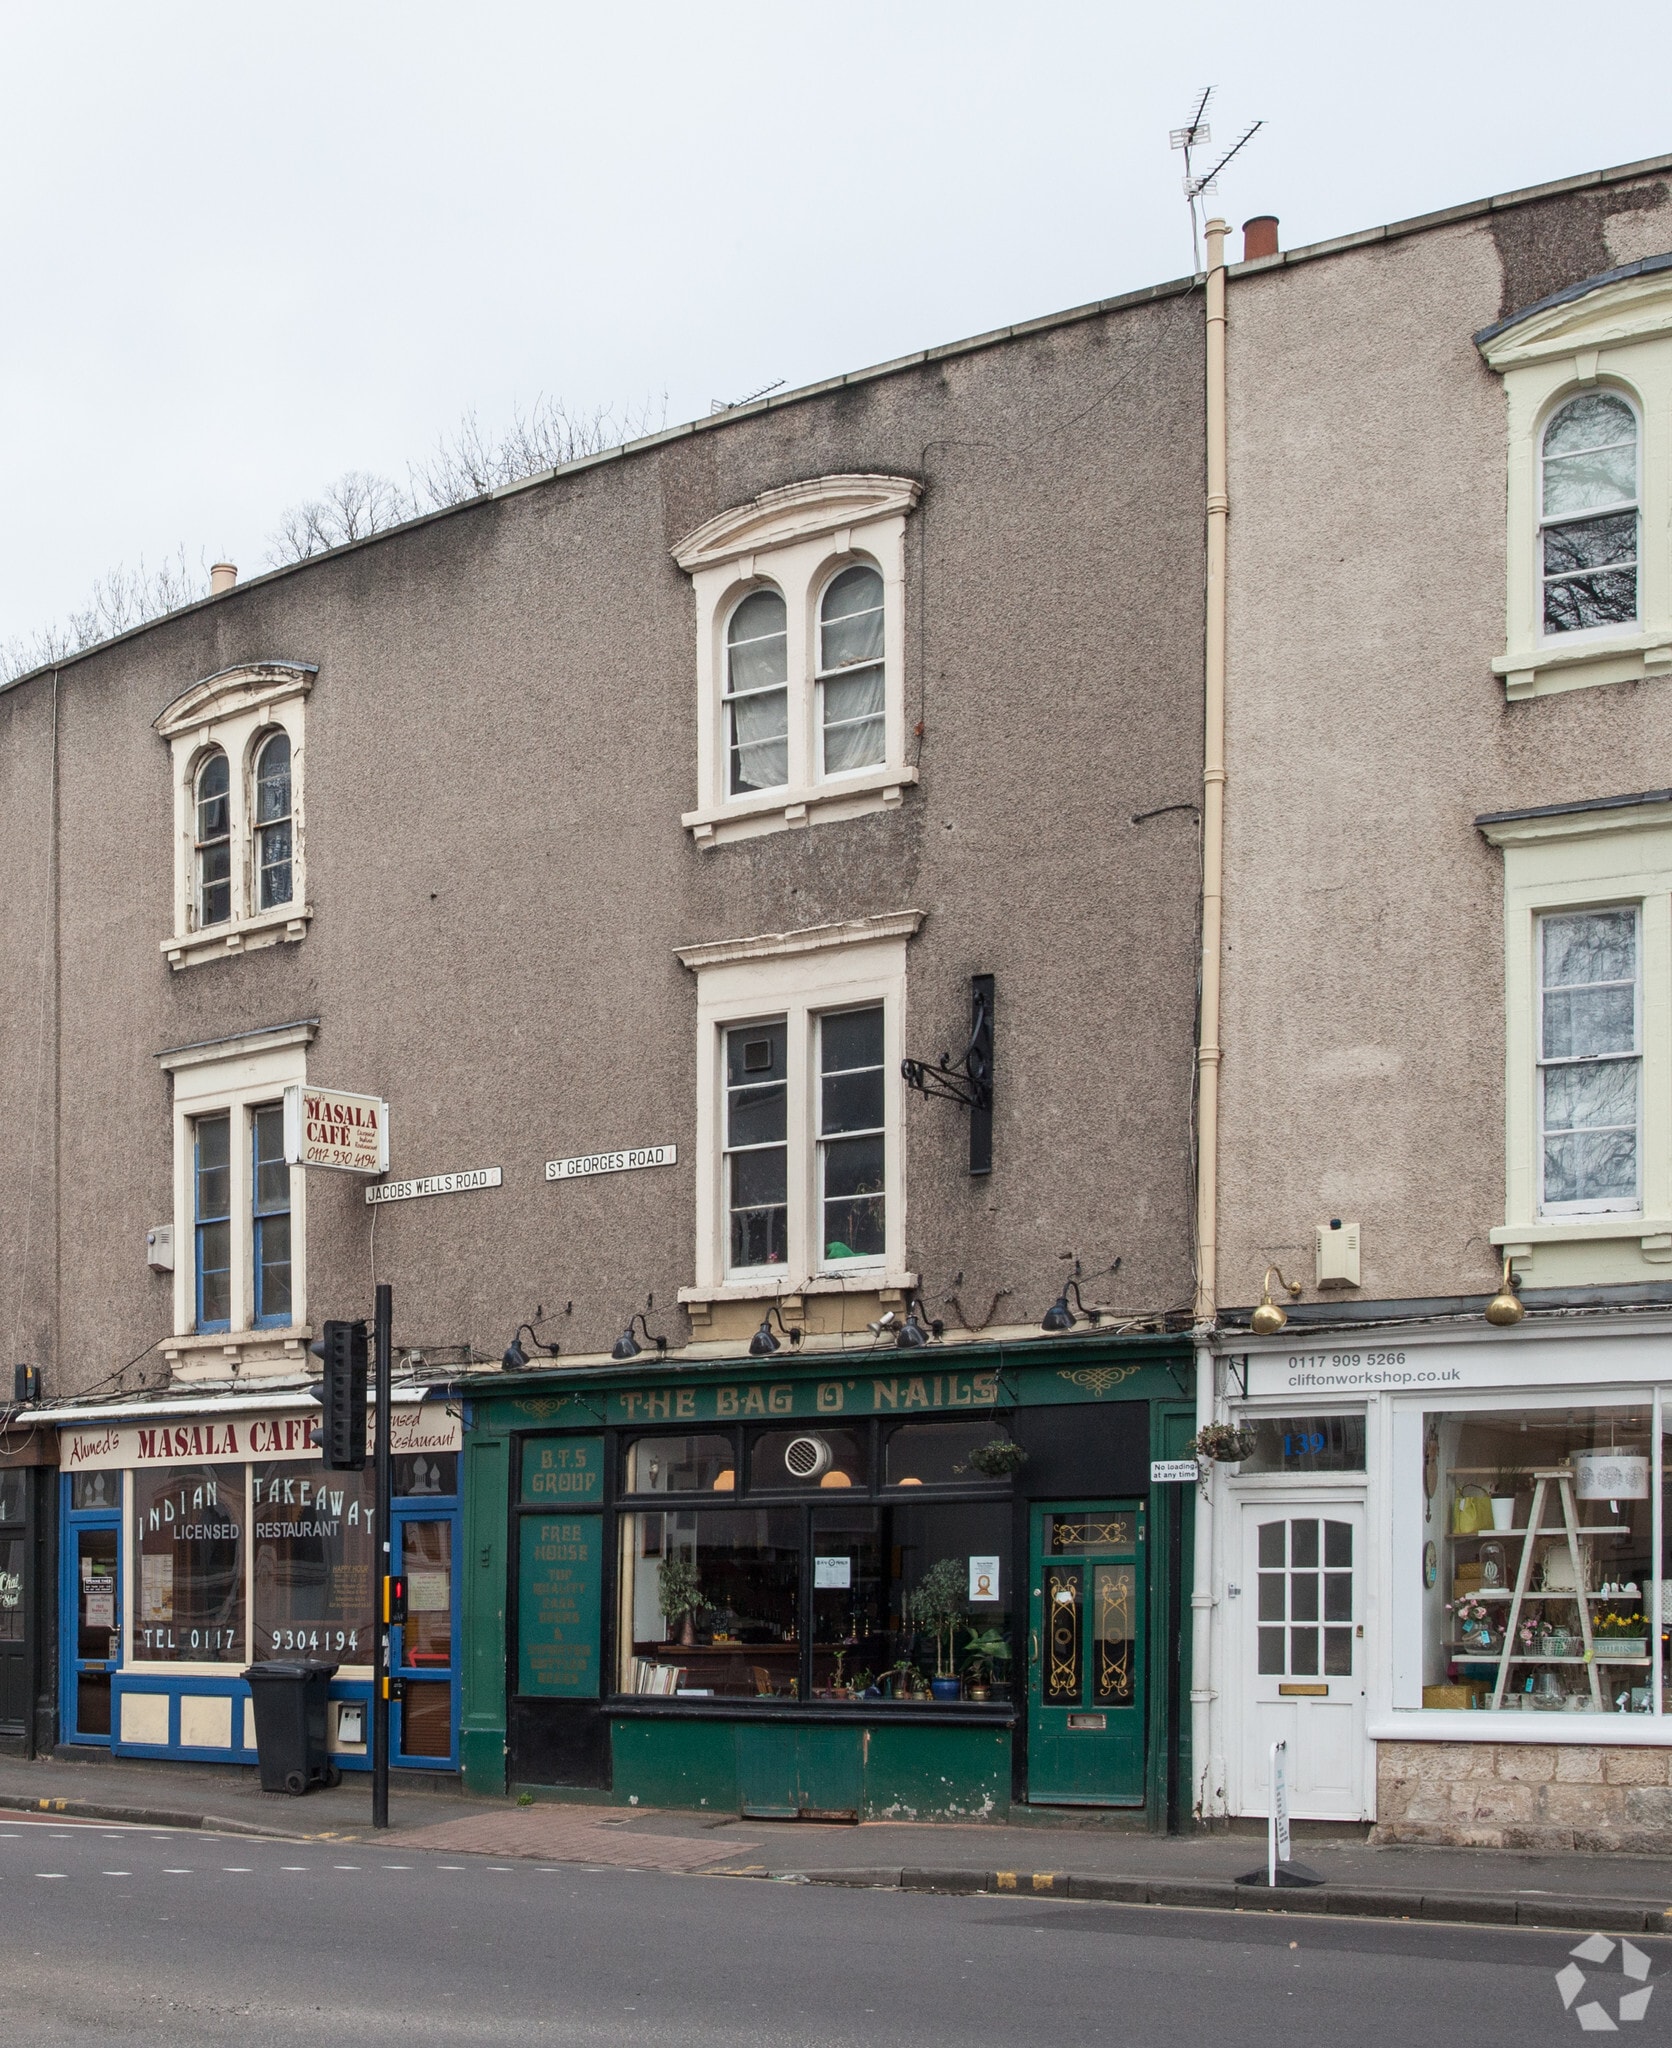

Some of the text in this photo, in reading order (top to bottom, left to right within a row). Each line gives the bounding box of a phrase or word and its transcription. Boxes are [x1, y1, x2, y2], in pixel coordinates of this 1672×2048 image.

[306, 1101, 378, 1129] MASALA
[306, 1122, 351, 1147] CAFÉ
[307, 1147, 376, 1168] 0117 930 4194
[567, 1154, 624, 1175] GEORGES
[629, 1148, 664, 1166] ROAD
[368, 1182, 412, 1202] JACOBS
[416, 1176, 452, 1194] WELLS
[456, 1171, 487, 1189] ROAD
[1288, 1352, 1406, 1369] 0117 909 5266
[1288, 1368, 1461, 1386] cliftonworkshop.co.uk
[620, 1372, 998, 1420] THE BAG O' NAILS
[70, 1428, 120, 1466] Ahmed's
[137, 1423, 239, 1459] MASALA
[1284, 1432, 1325, 1457] 139
[1167, 1463, 1195, 1471] loading
[531, 1472, 597, 1494] GROUP
[139, 1477, 375, 1541] INDIAN TAKEAWAY
[173, 1520, 340, 1540] LICENSED RESTAURANT
[541, 1525, 582, 1542] FREE
[534, 1545, 589, 1561] HOUSE
[144, 1628, 358, 1651] TEL 0117 9304194
